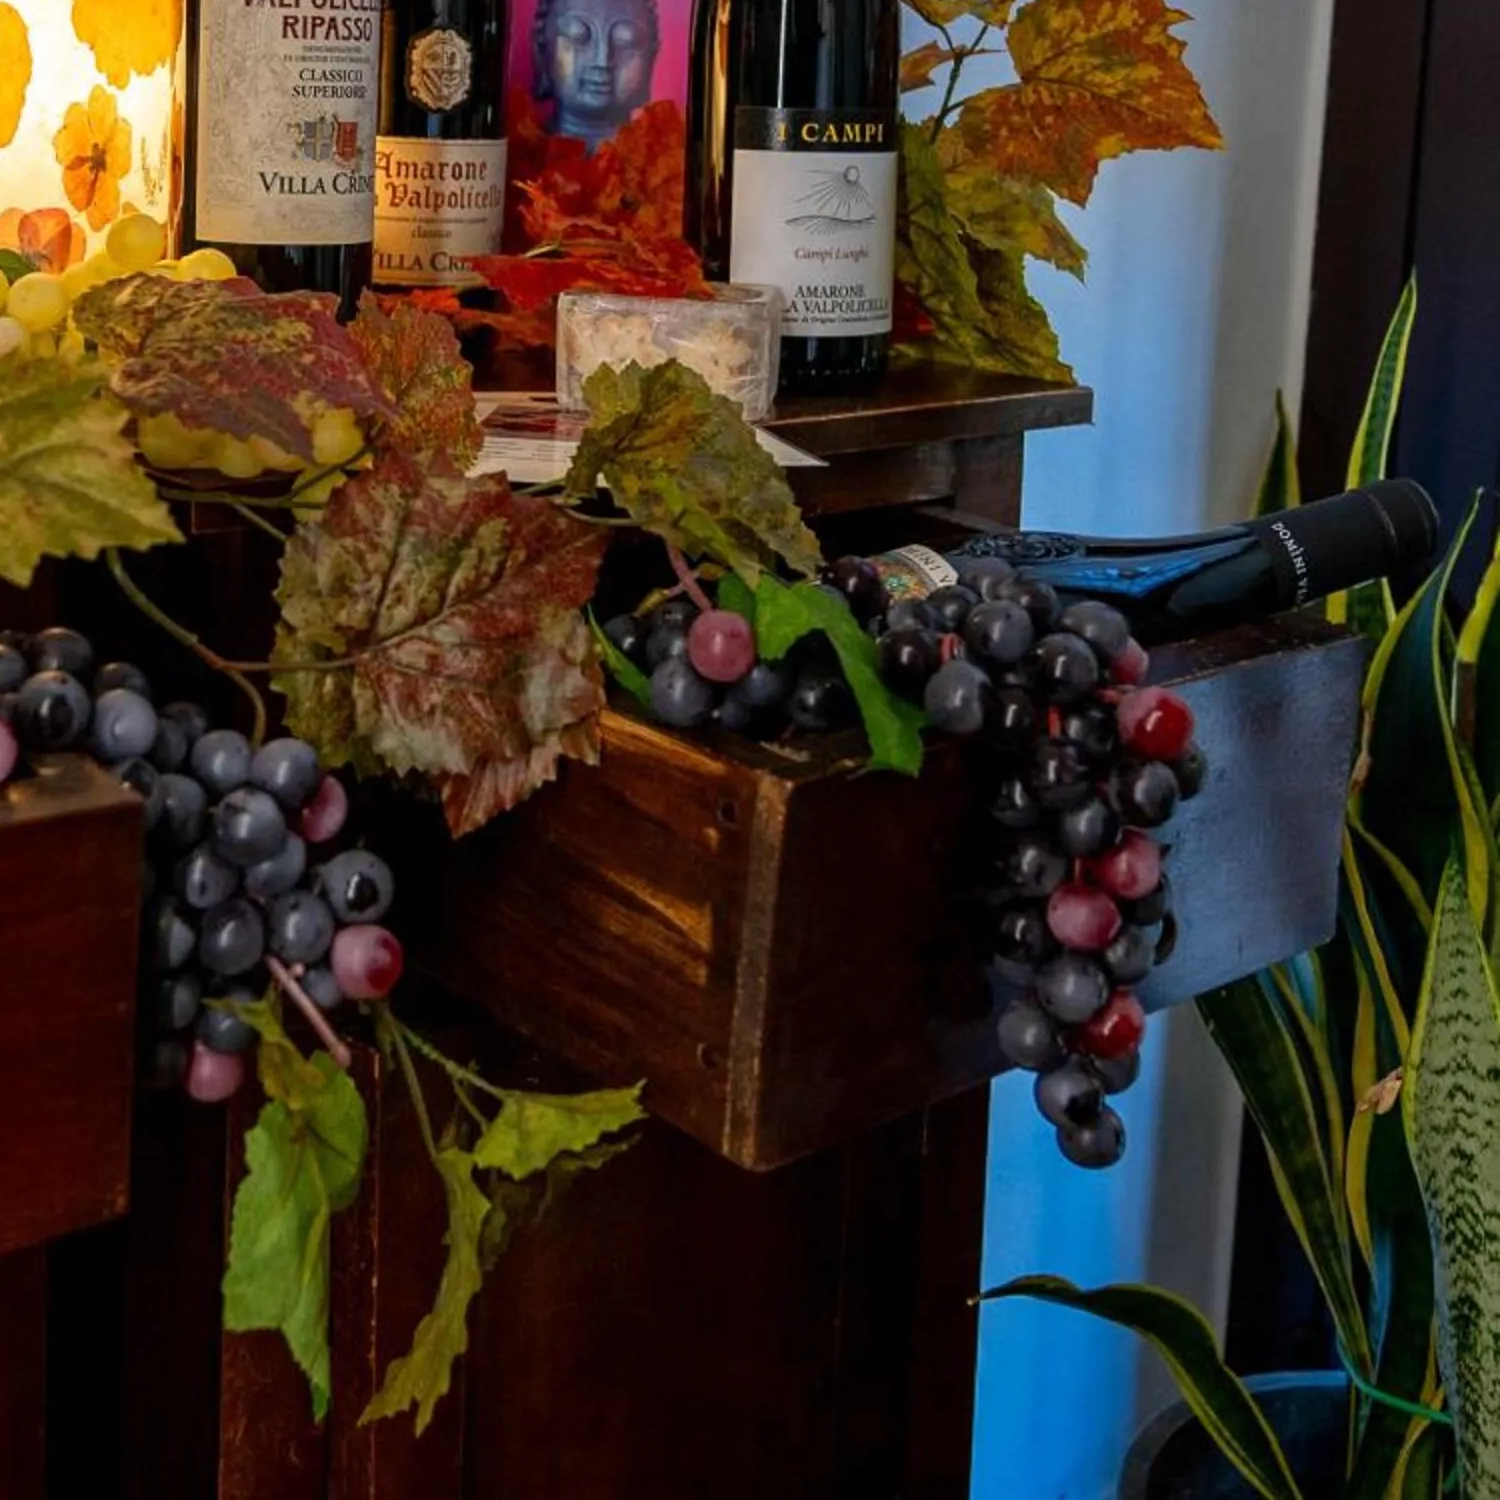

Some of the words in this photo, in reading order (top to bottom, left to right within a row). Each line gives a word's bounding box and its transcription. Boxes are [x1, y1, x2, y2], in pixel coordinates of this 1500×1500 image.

[281, 14, 374, 42] RIPASSO
[299, 66, 364, 83] CLASSICO
[291, 84, 368, 100] SUPERIORE
[776, 122, 788, 142] I
[801, 122, 885, 143] CAMPI
[375, 150, 488, 182] Amarone
[258, 171, 327, 195] VILLA
[794, 284, 867, 299] AMARONE
